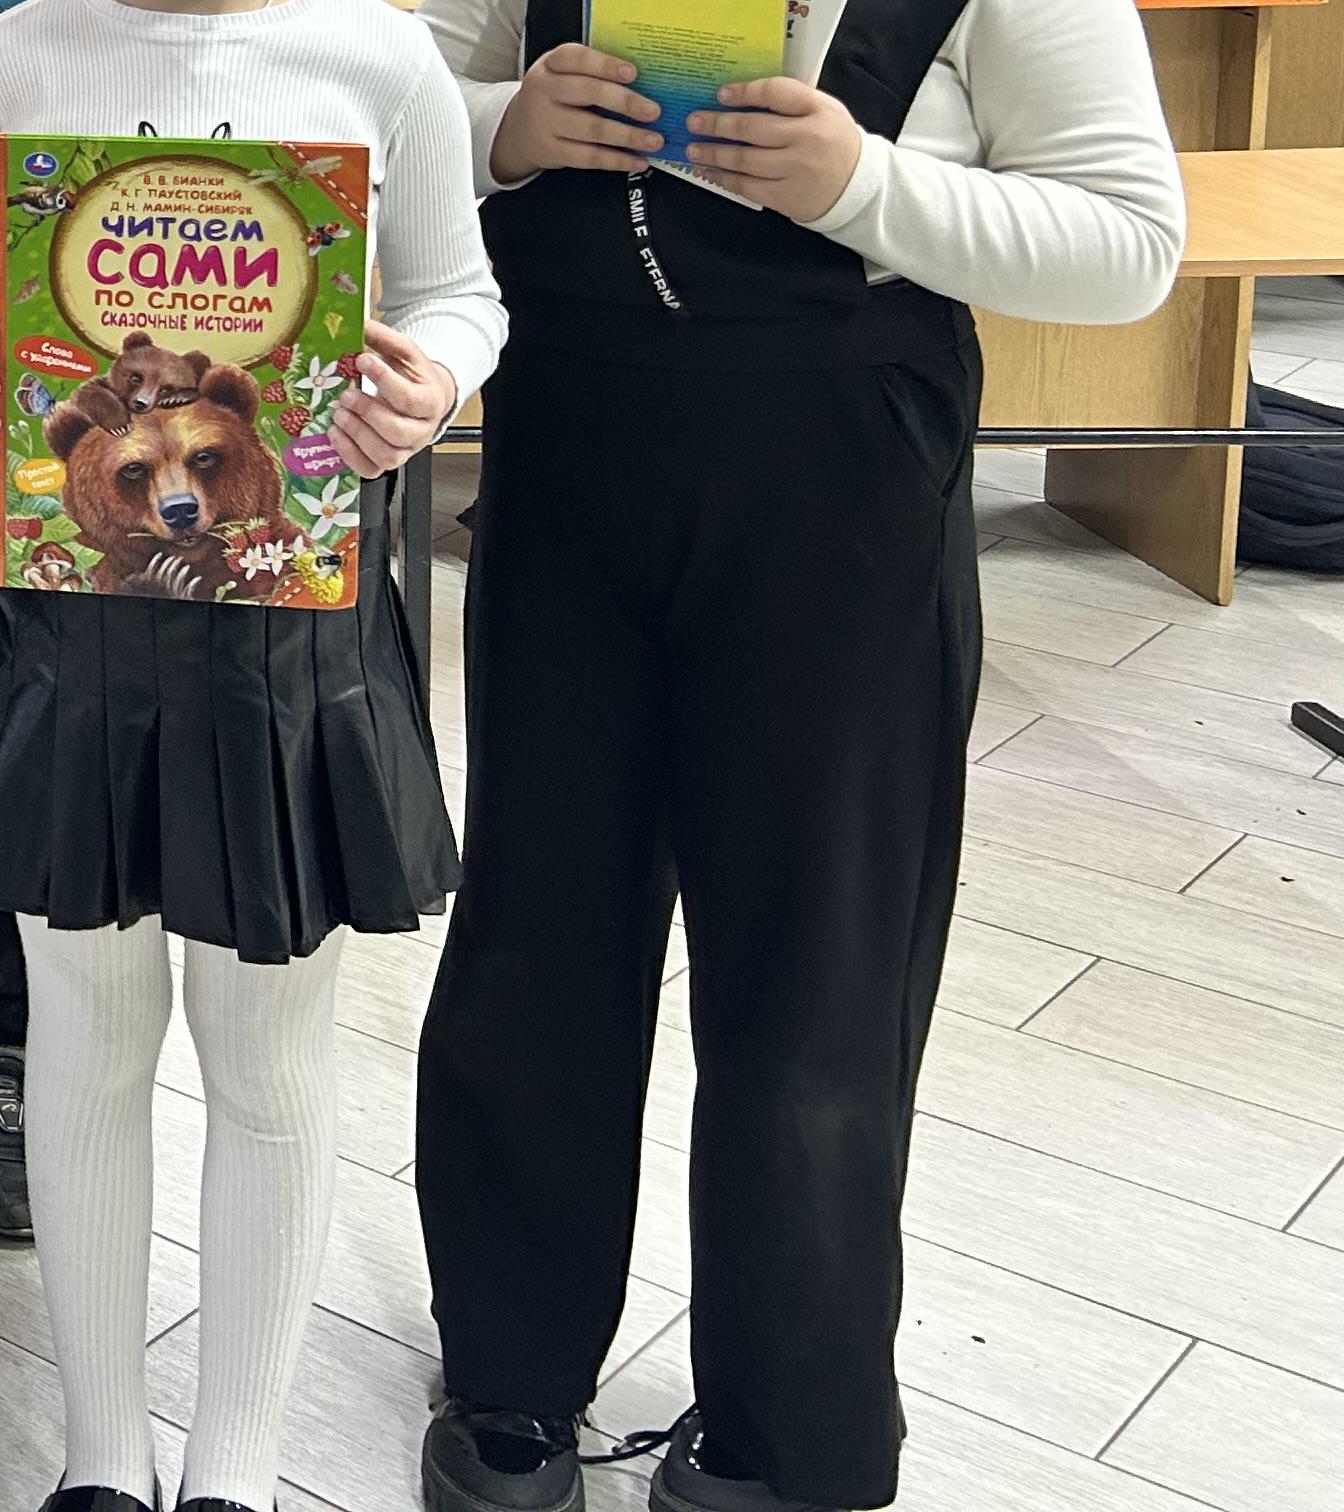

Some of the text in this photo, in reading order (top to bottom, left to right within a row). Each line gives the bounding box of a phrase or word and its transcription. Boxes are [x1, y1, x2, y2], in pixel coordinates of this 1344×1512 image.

[173, 176, 224, 186] БИАНКИ
[149, 189, 242, 201] ПАУСТОВСКИЙ
[143, 202, 253, 215] МАМИН-СИБИРЯК
[100, 310, 264, 333] СКАЗОЧНЫЕ ИСТОРИИ
